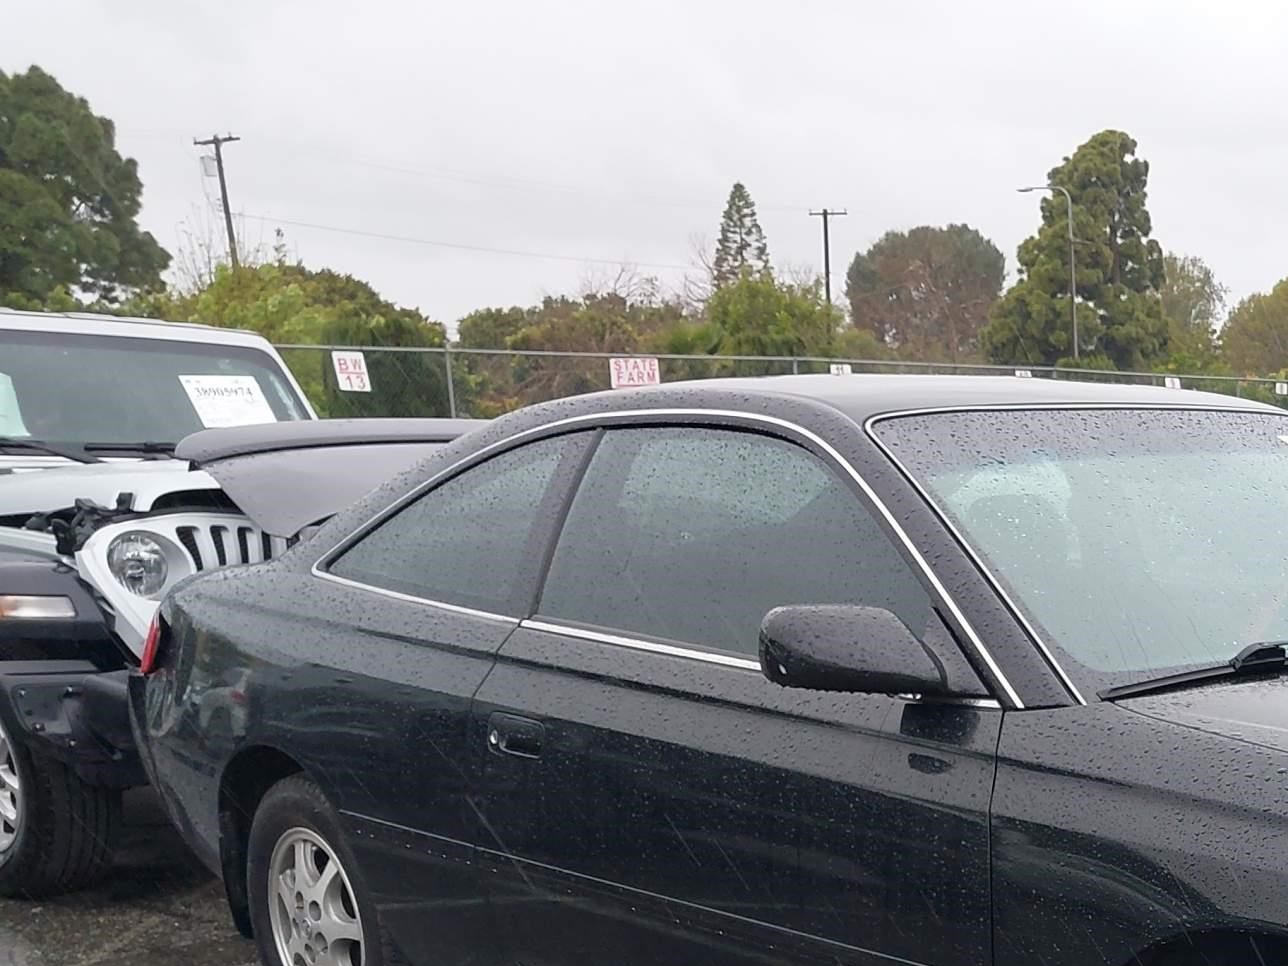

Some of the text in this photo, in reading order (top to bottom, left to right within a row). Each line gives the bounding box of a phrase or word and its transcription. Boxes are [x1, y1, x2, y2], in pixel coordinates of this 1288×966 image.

[614, 359, 657, 371] STATE
[345, 375, 366, 390] 13
[616, 370, 656, 384] FARM
